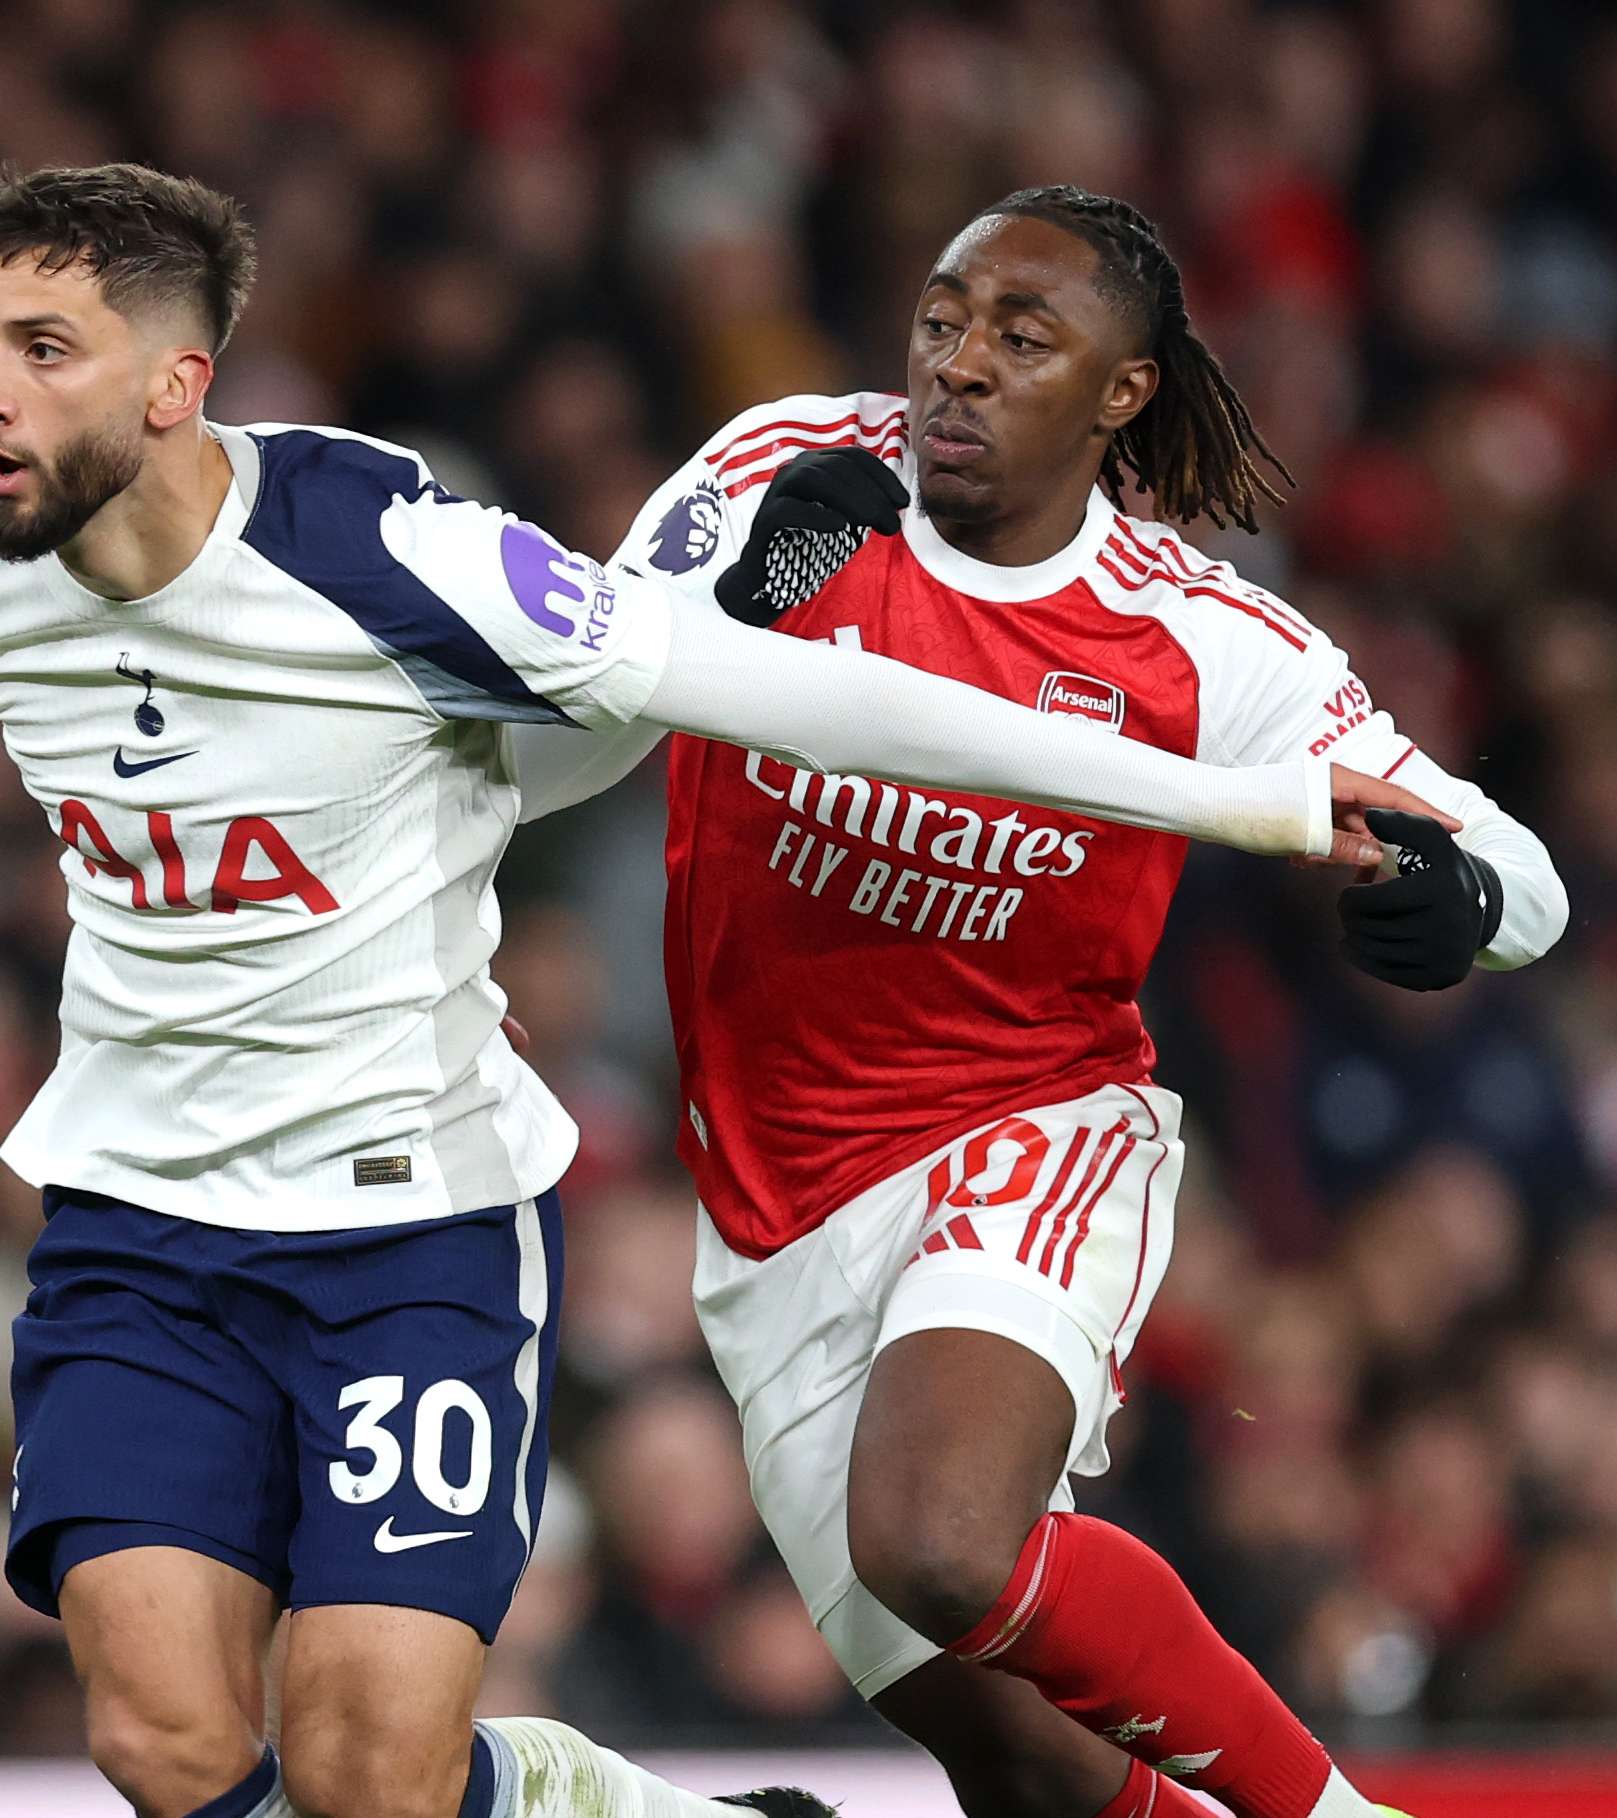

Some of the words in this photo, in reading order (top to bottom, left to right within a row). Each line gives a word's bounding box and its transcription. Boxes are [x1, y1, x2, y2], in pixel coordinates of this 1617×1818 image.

[1051, 686, 1113, 713] Arsenal
[1323, 680, 1374, 717] VIS
[59, 799, 341, 915] AIA
[767, 820, 848, 897] FLY
[849, 858, 1024, 942] BETTER
[920, 1117, 1051, 1228] 10
[329, 1375, 492, 1516] 30
